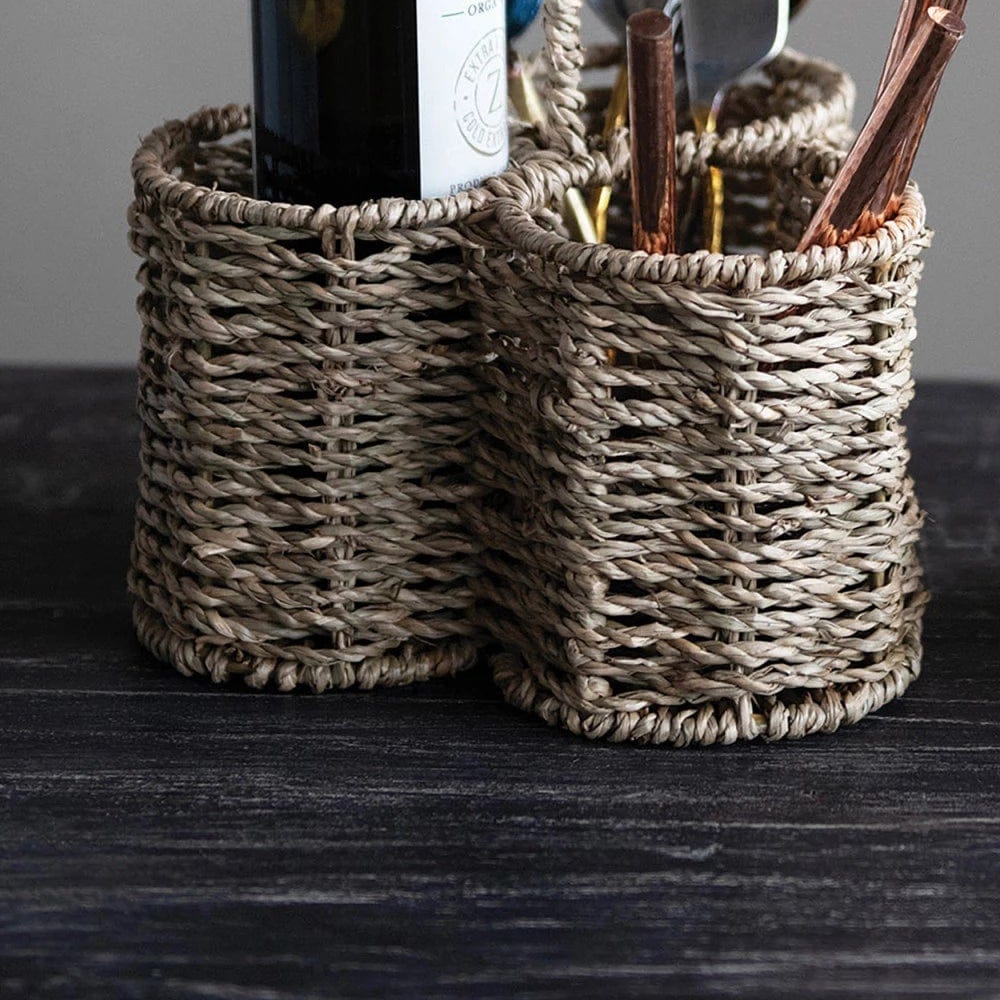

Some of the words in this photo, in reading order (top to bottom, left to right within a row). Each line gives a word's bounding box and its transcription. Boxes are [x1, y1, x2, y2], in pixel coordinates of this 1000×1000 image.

[464, 39, 494, 83] EXTRA
[462, 111, 486, 144] COLD
[449, 178, 482, 194] PROD
